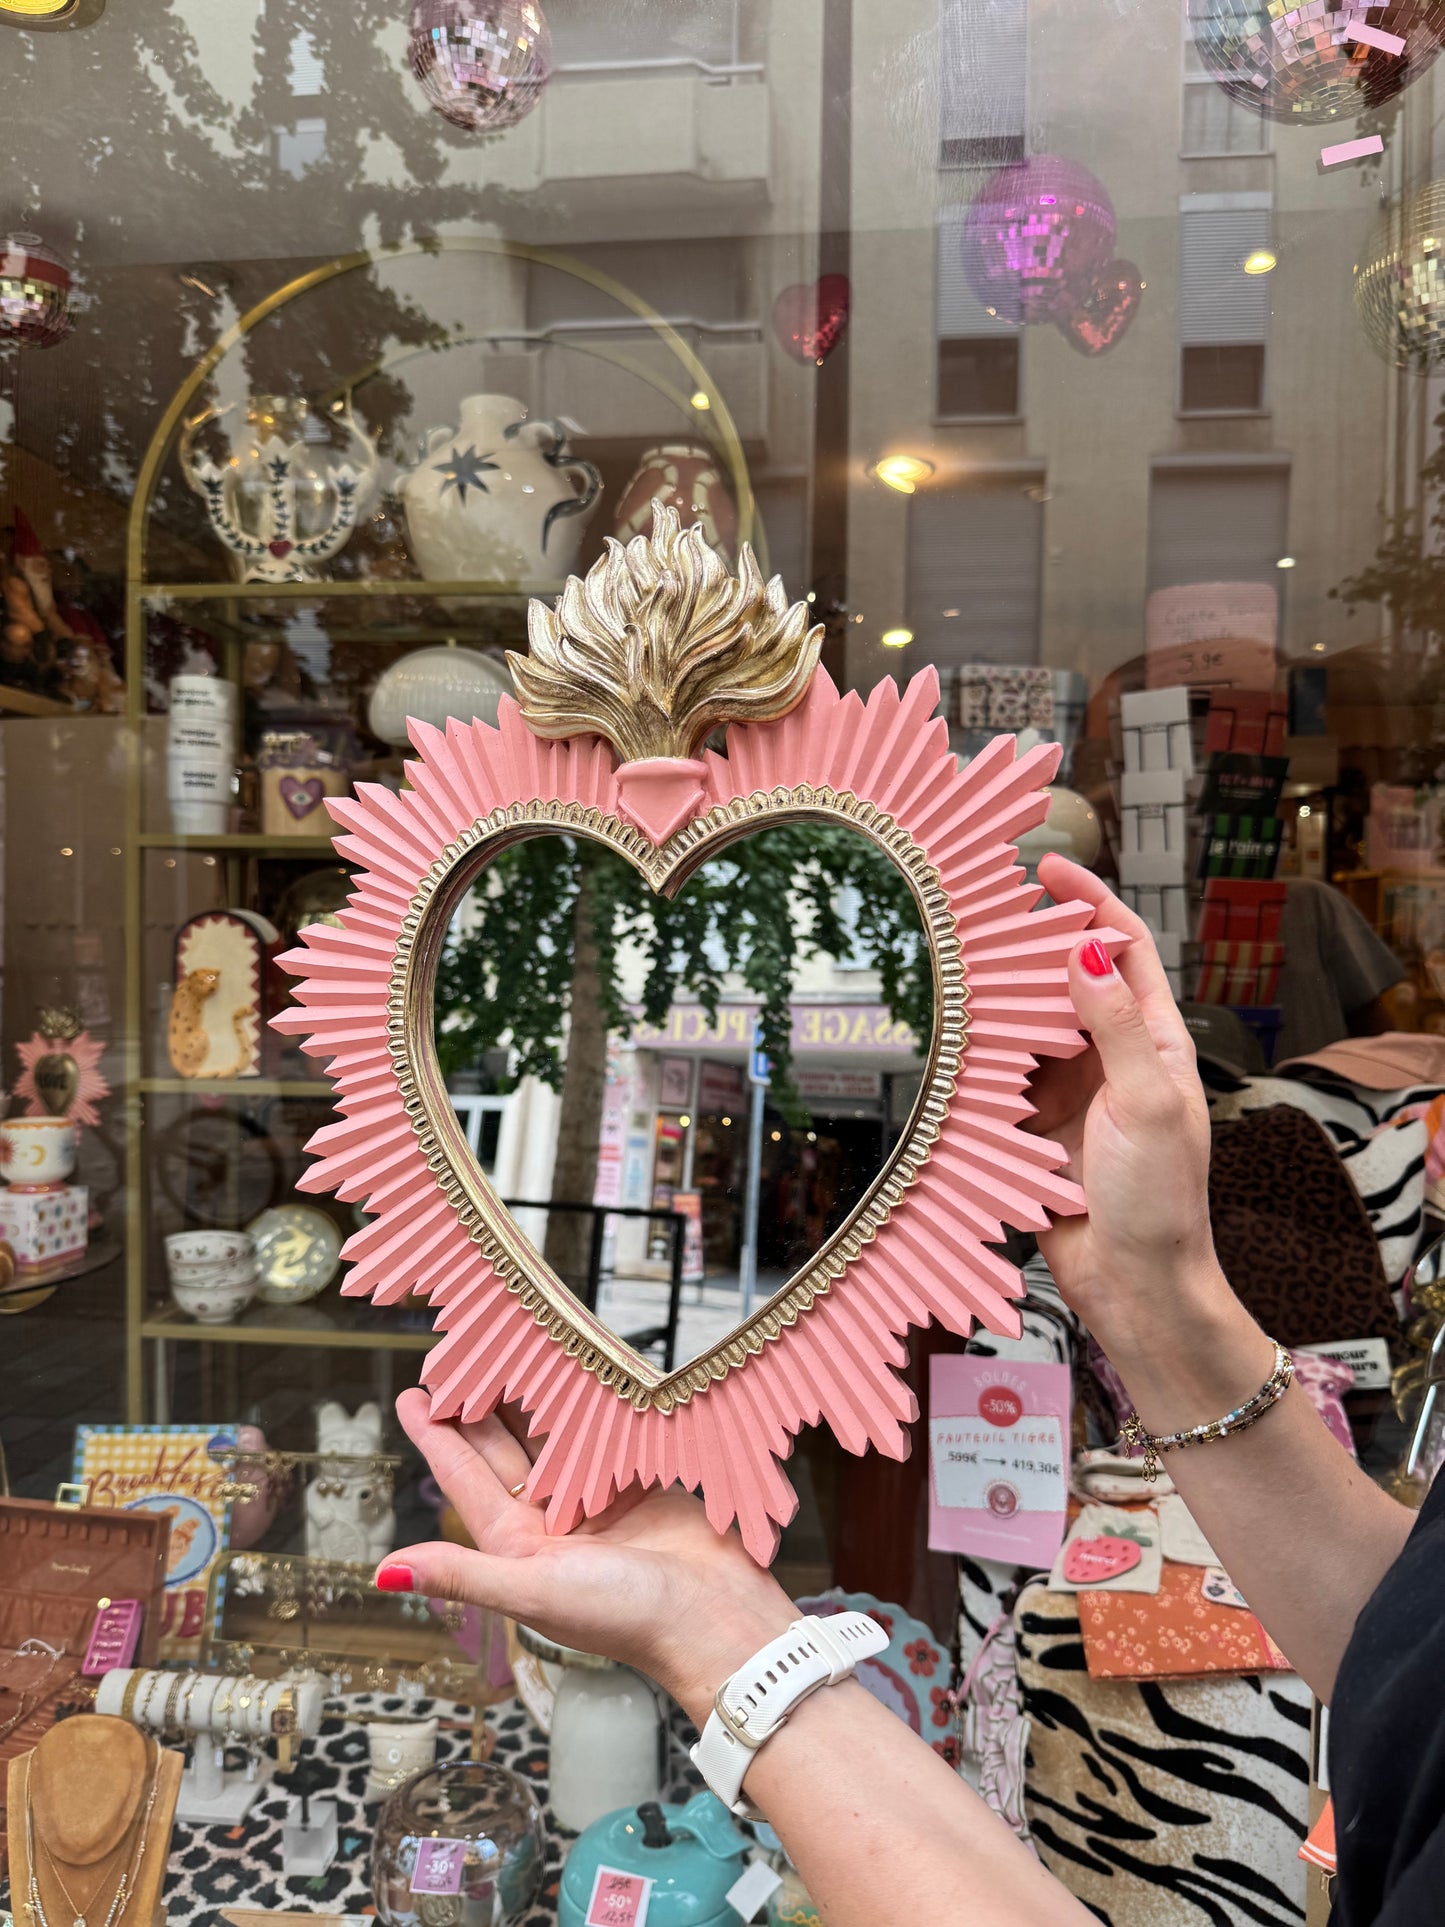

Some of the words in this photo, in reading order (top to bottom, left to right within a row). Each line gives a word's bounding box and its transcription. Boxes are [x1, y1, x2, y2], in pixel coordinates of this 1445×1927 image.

[973, 1371, 1027, 1392] SOLDES
[937, 1432, 1004, 1446] FAUTEUIL
[1013, 1433, 1055, 1445] TIGRE
[1011, 1460, 1060, 1476] 419,30€
